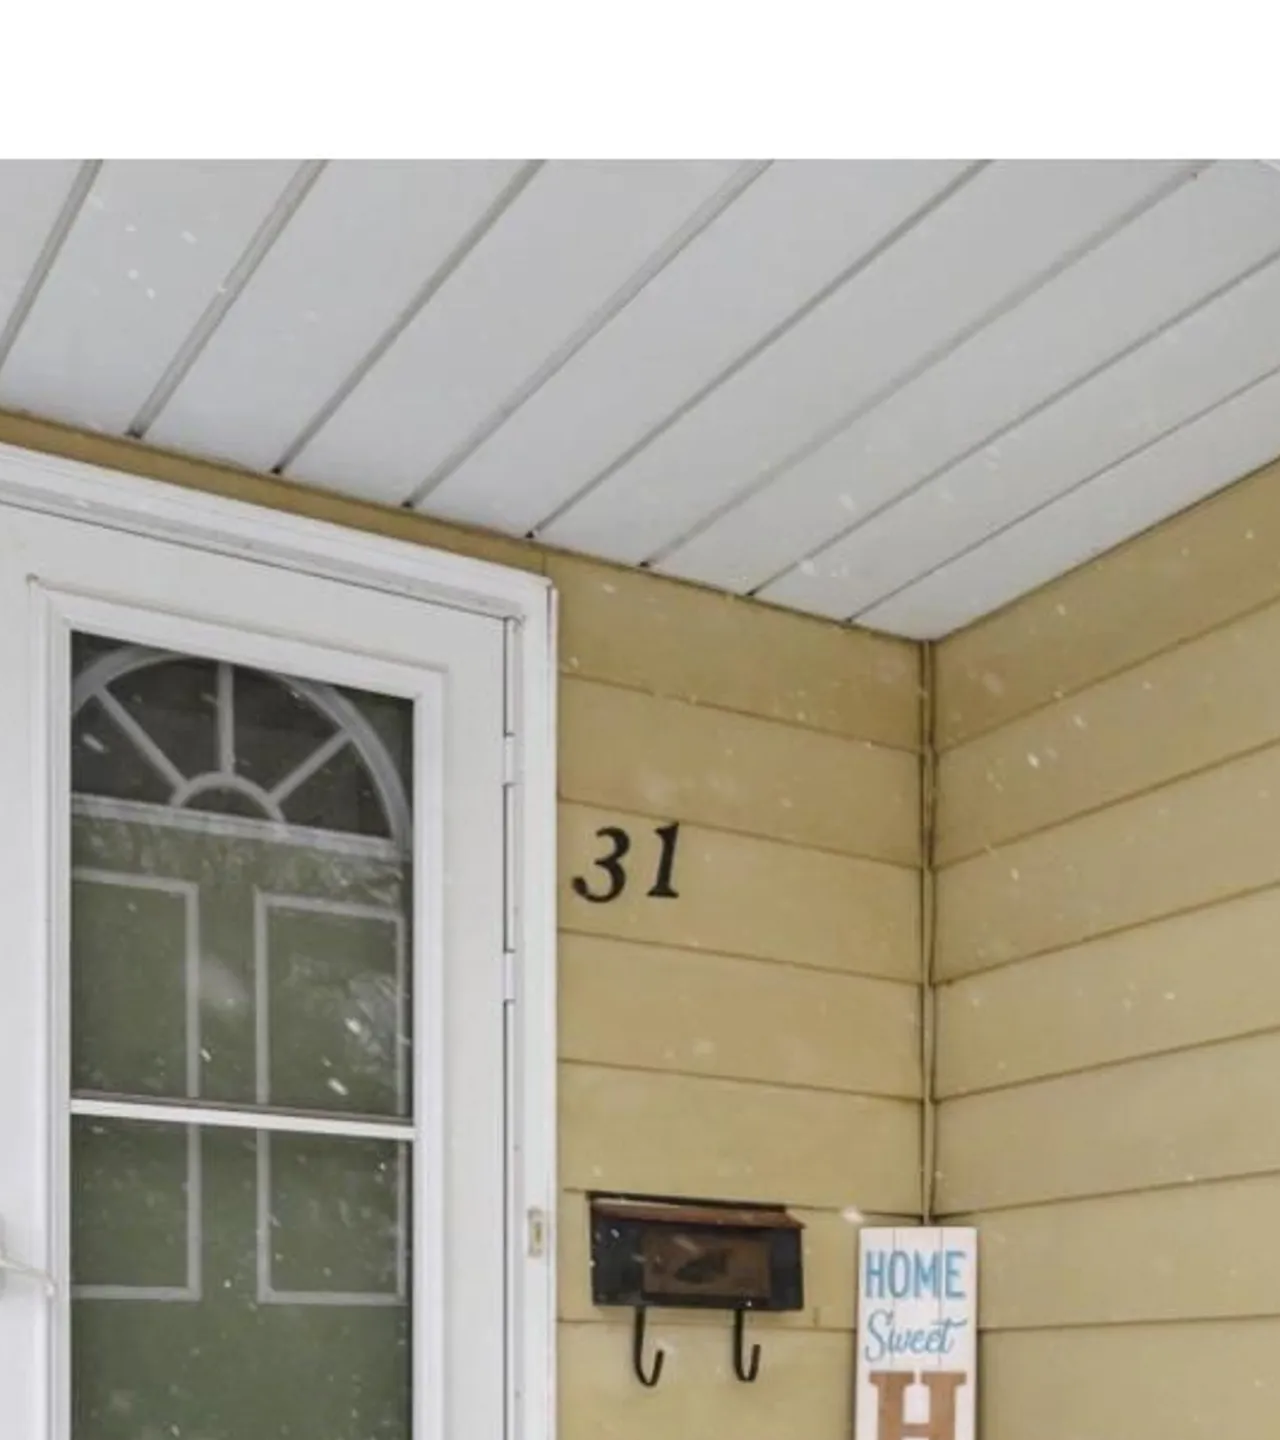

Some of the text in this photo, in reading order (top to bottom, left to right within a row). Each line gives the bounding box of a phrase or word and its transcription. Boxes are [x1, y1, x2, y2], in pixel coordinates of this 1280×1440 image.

[572, 820, 680, 904] 31
[865, 1250, 967, 1299] HOME
[864, 1308, 967, 1362] Sweet
